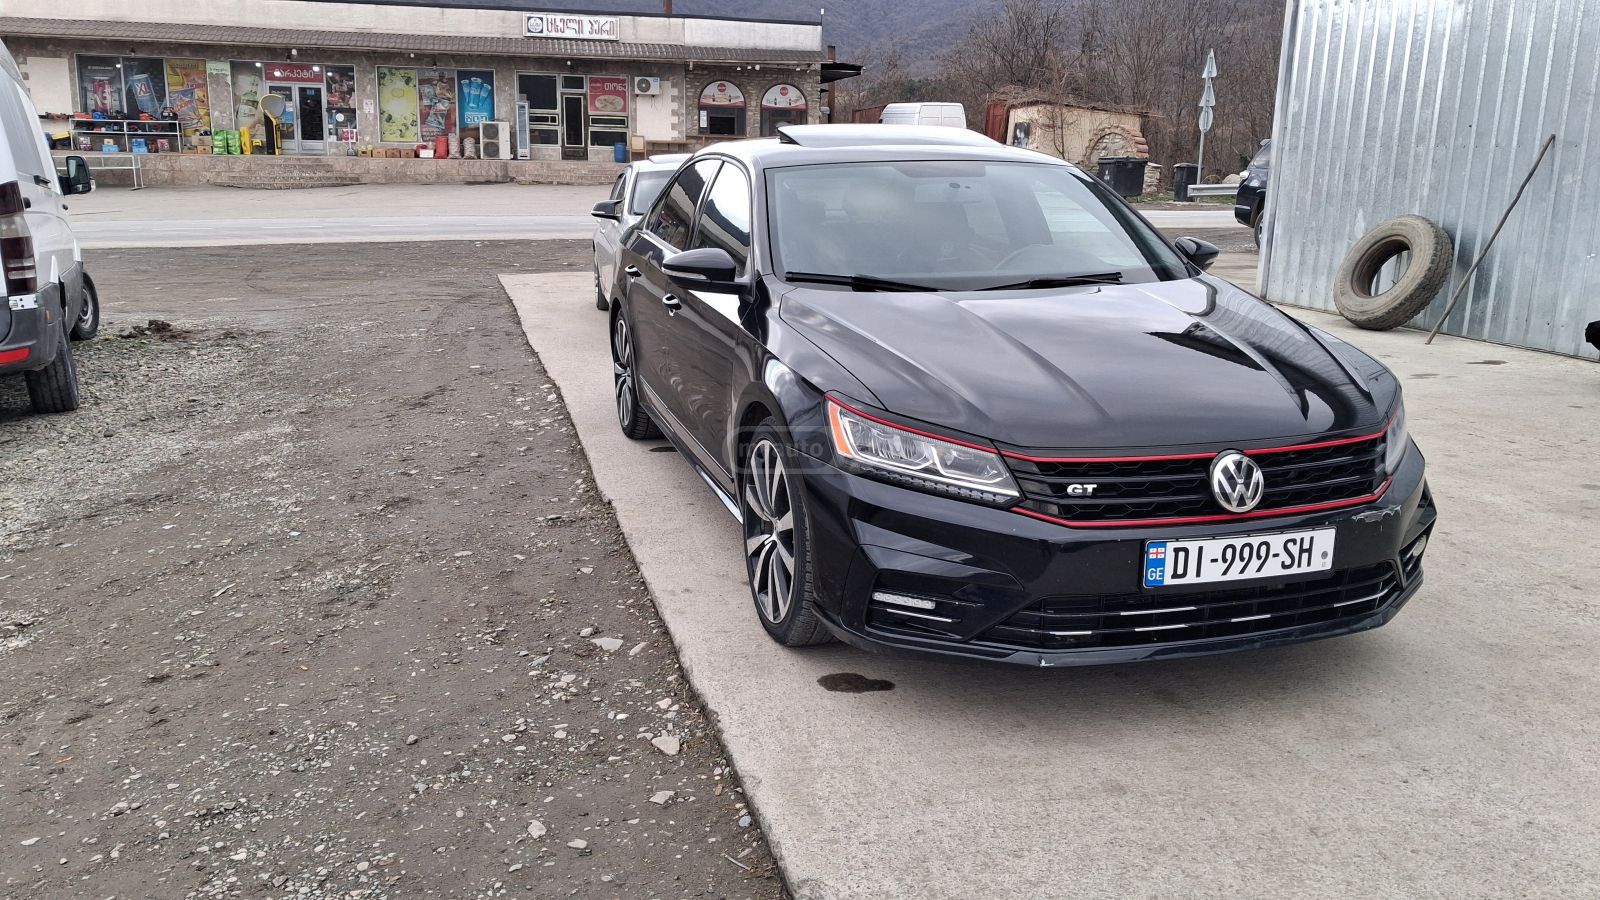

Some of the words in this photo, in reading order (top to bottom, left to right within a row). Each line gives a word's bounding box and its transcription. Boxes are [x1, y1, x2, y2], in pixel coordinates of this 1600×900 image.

[588, 20, 615, 36] პური
[136, 82, 151, 96] XL
[1066, 484, 1097, 496] GT
[1171, 536, 1314, 580] DI-999-SH
[1147, 567, 1164, 581] GE
